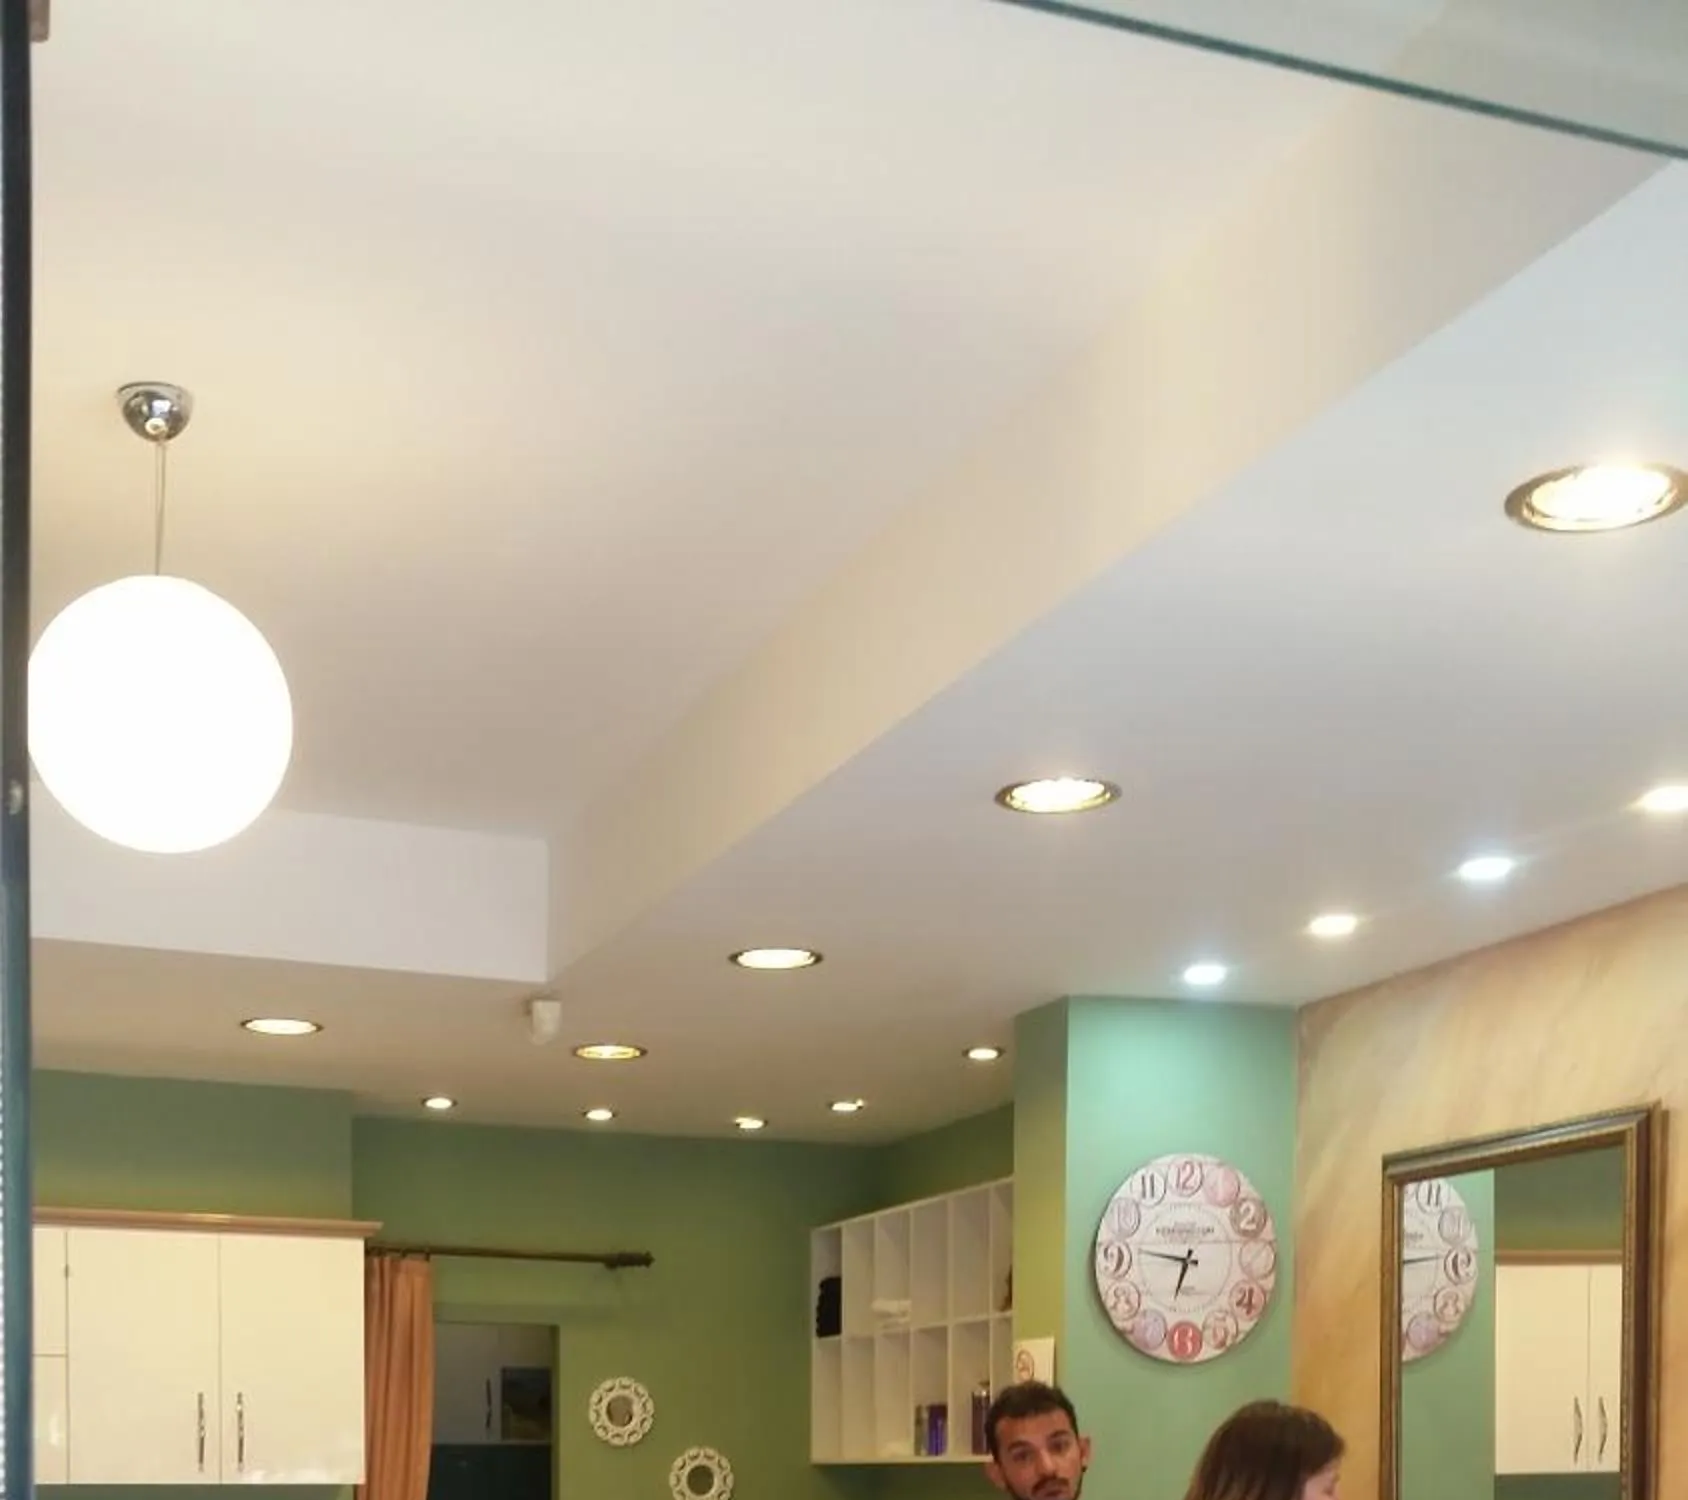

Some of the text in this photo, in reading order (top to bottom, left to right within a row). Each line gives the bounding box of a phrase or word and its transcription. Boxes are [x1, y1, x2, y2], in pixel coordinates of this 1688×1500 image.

[1141, 1173, 1155, 1199] 11
[1175, 1160, 1195, 1191] 12
[1240, 1200, 1257, 1231] 2
[1102, 1246, 1125, 1274] 9
[1235, 1286, 1254, 1317] 4
